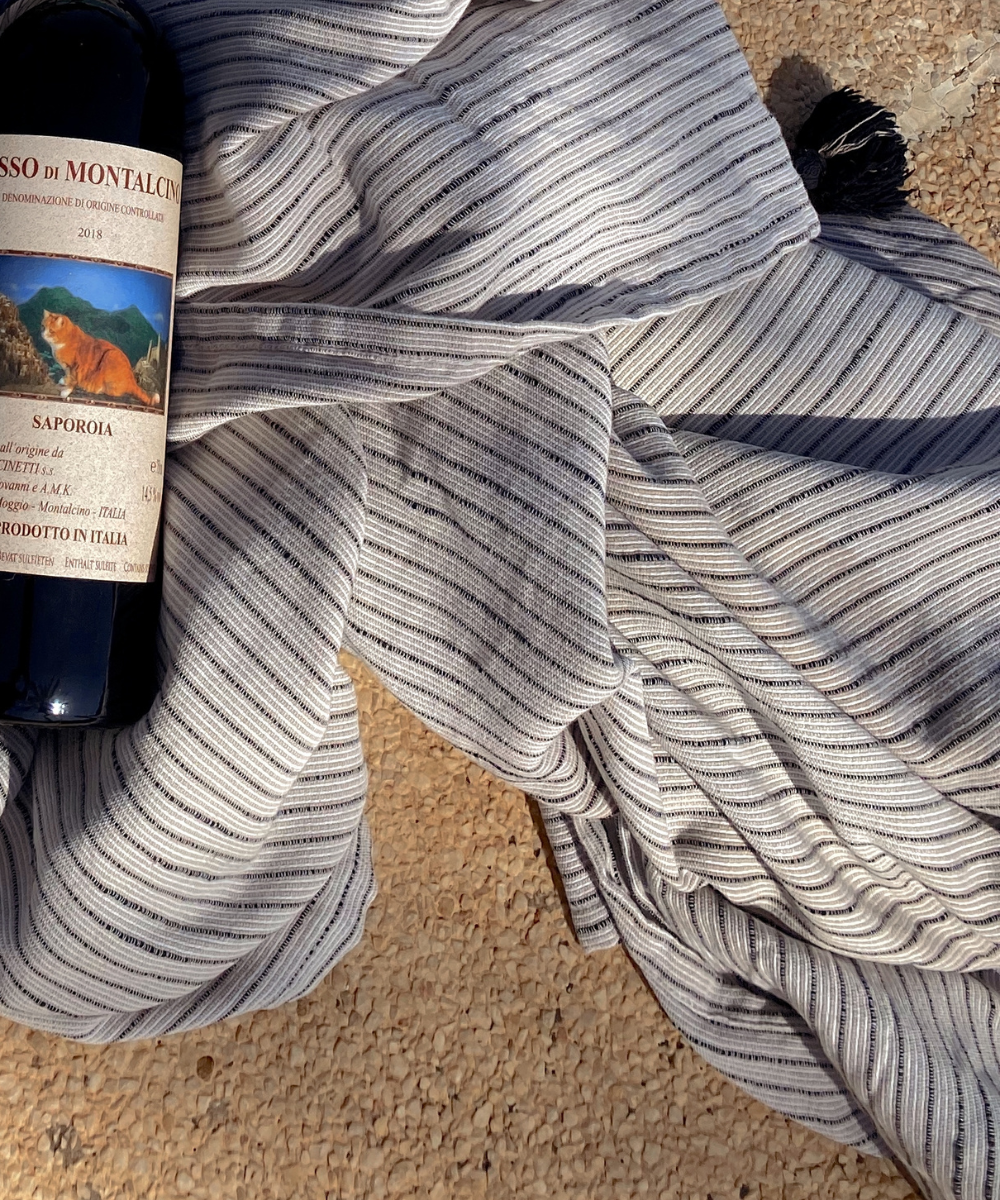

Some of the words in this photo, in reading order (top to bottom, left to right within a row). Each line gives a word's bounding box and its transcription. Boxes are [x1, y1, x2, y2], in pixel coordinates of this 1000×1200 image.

[65, 159, 181, 205] MONTALCINO
[1, 192, 74, 207] DENOMINAZIONE
[75, 199, 85, 208] DI
[86, 199, 120, 214] ORIGINE
[77, 227, 103, 240] 2018
[32, 414, 113, 437] SAPOROIA
[51, 447, 65, 459] da
[32, 485, 38, 493] e
[38, 500, 91, 517] Montalcino
[98, 506, 127, 520] ITALIA
[73, 528, 88, 543] IN
[90, 529, 128, 546] ITALIA
